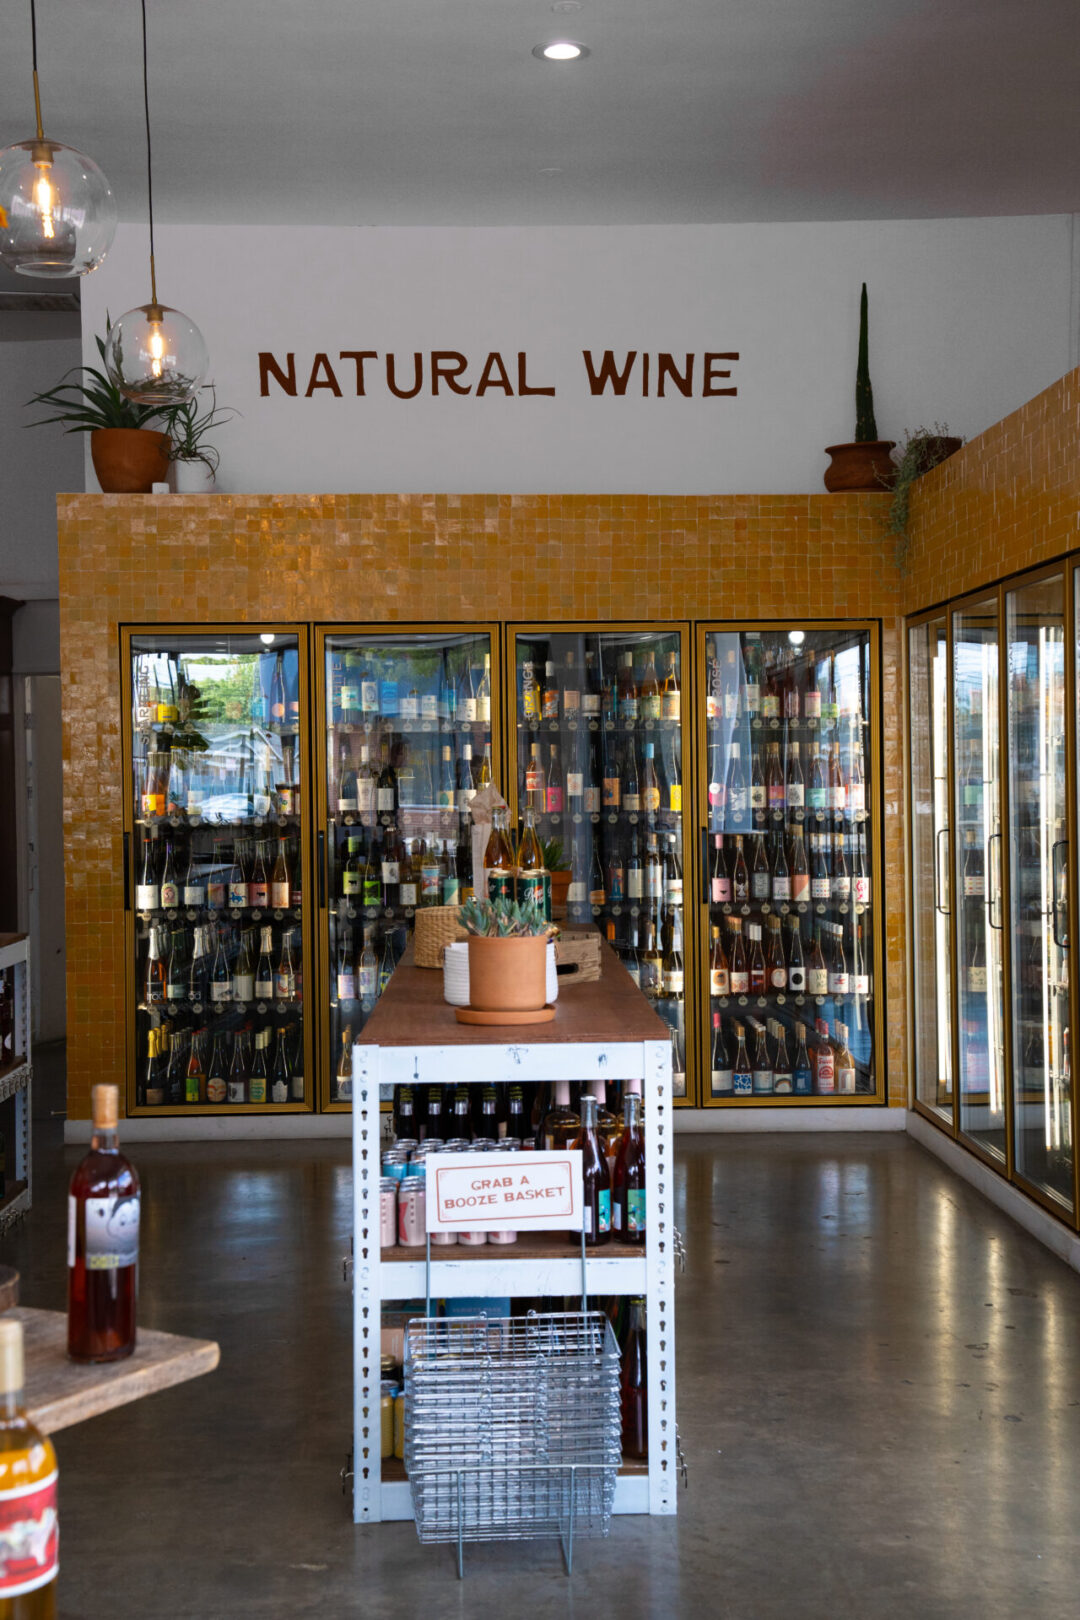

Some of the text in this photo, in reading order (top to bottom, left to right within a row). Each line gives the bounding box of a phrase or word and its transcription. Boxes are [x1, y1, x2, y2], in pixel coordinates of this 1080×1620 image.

[258, 350, 740, 400] NATURAL WINE
[470, 1175, 530, 1191] GRAB A
[444, 1186, 565, 1210] BOOZE BASKET
